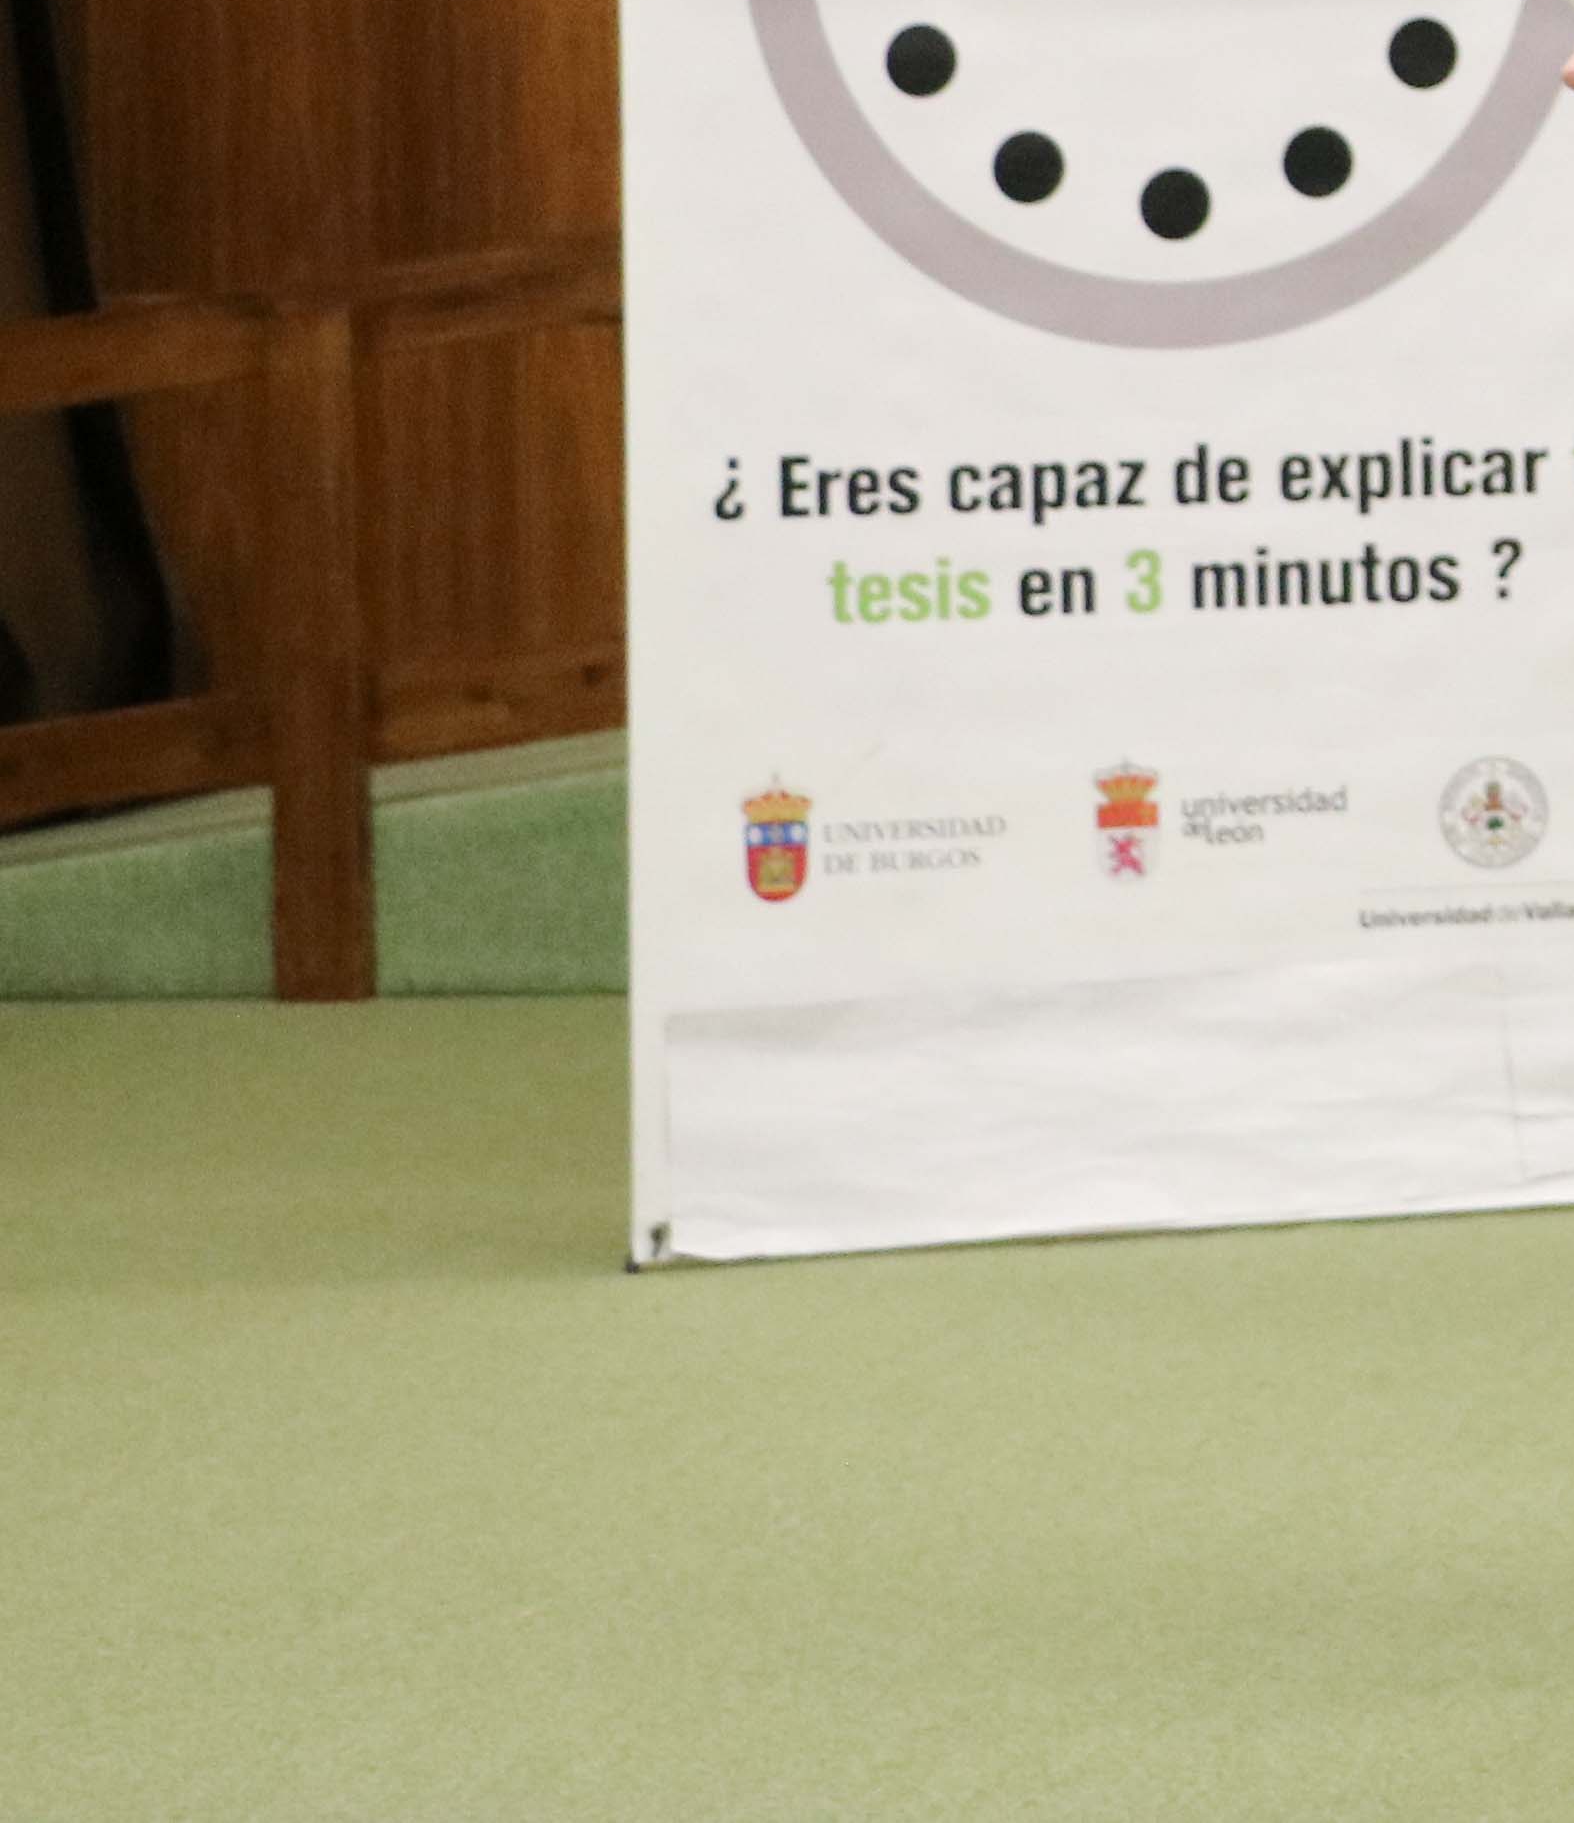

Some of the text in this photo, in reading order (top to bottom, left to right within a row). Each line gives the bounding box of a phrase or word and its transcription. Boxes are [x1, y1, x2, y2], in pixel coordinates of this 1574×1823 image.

[713, 458, 745, 521] ¿
[778, 455, 920, 518] Eres
[948, 458, 1147, 525] capaz
[1174, 444, 1251, 507] de
[1279, 437, 1549, 515] explicar
[828, 539, 1523, 626] tesis en 3 minutos ?
[1181, 785, 1349, 820] universidad
[822, 815, 1007, 846] UNIVERSIDAD
[822, 846, 982, 876] DE BURGOS
[1358, 903, 1493, 930] Universidad
